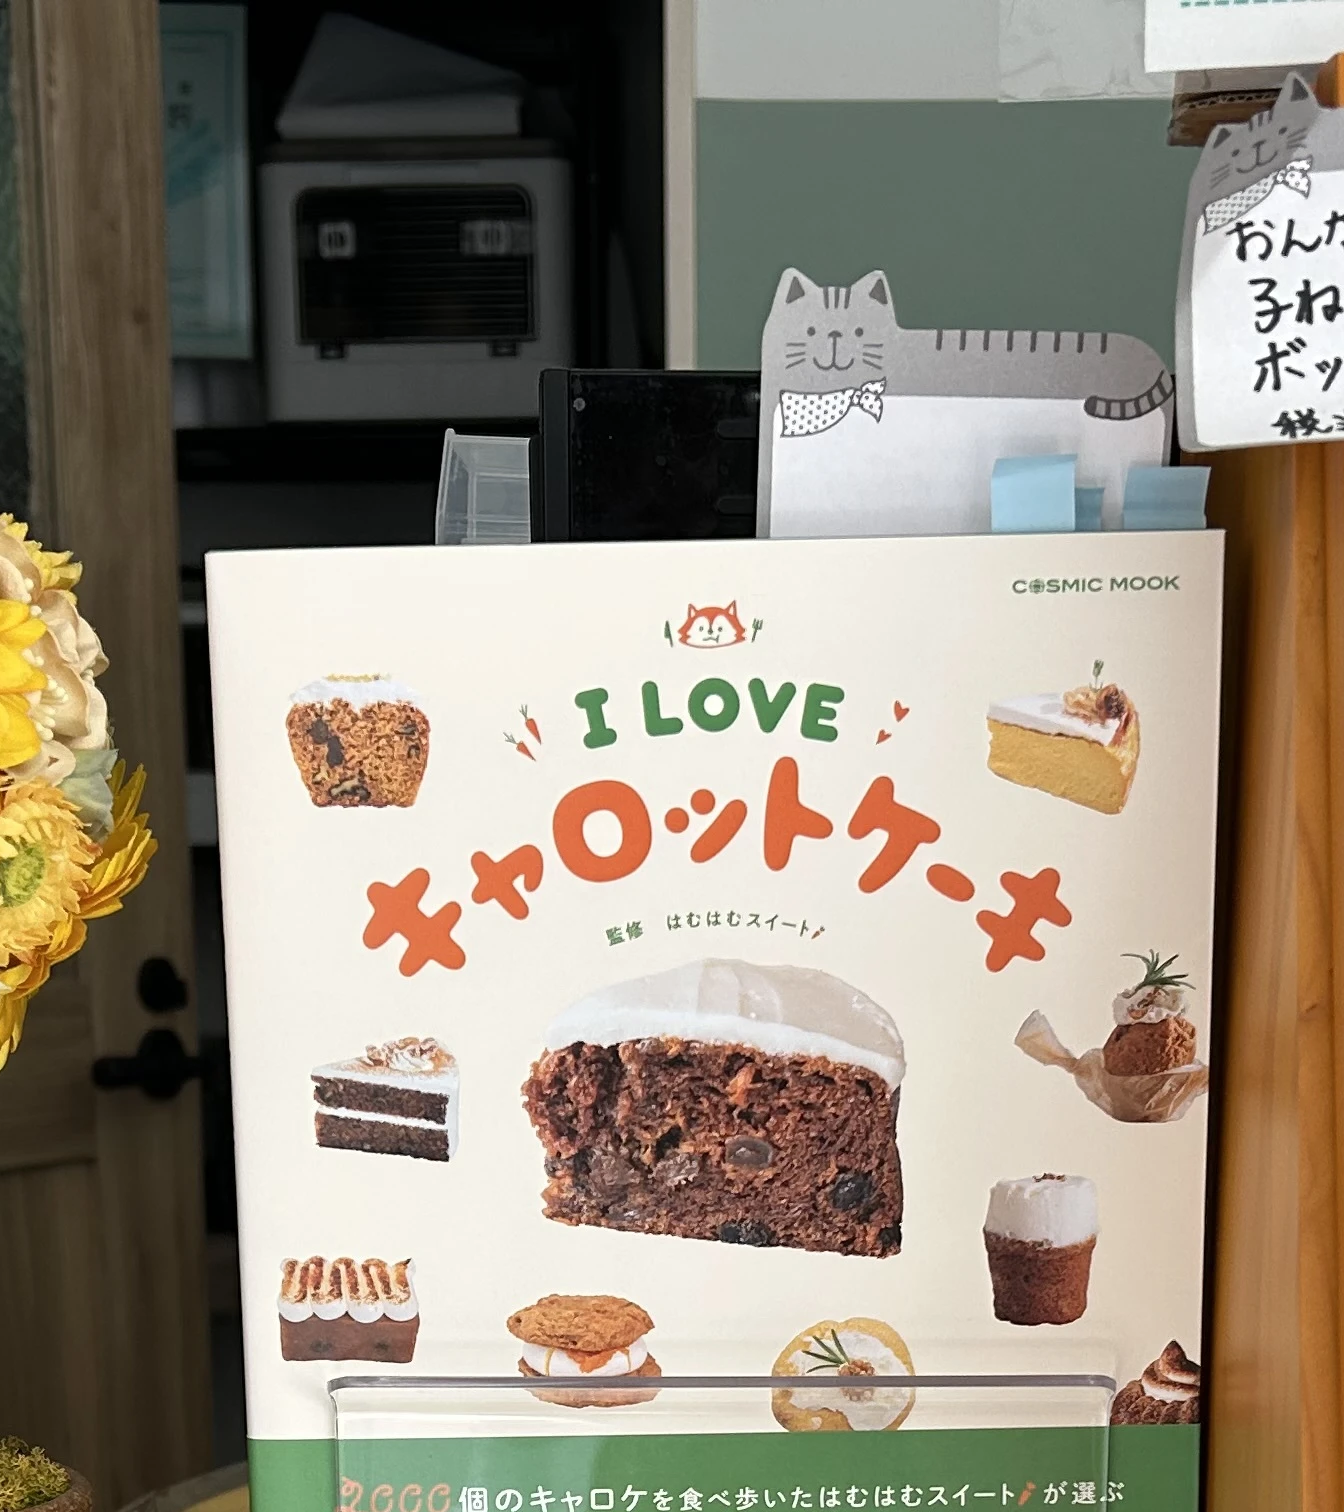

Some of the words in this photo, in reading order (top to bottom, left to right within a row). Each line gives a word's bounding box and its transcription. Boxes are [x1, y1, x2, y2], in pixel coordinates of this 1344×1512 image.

[1012, 577, 1104, 595] COSMIC
[1109, 575, 1181, 592] MOOK
[573, 686, 619, 750] I
[640, 676, 846, 744] LOVE
[361, 755, 1073, 978] キャロットケーキ
[605, 920, 645, 947] 監修
[666, 909, 810, 938] はむはむスイート
[1043, 1480, 1126, 1506] が選ぶ
